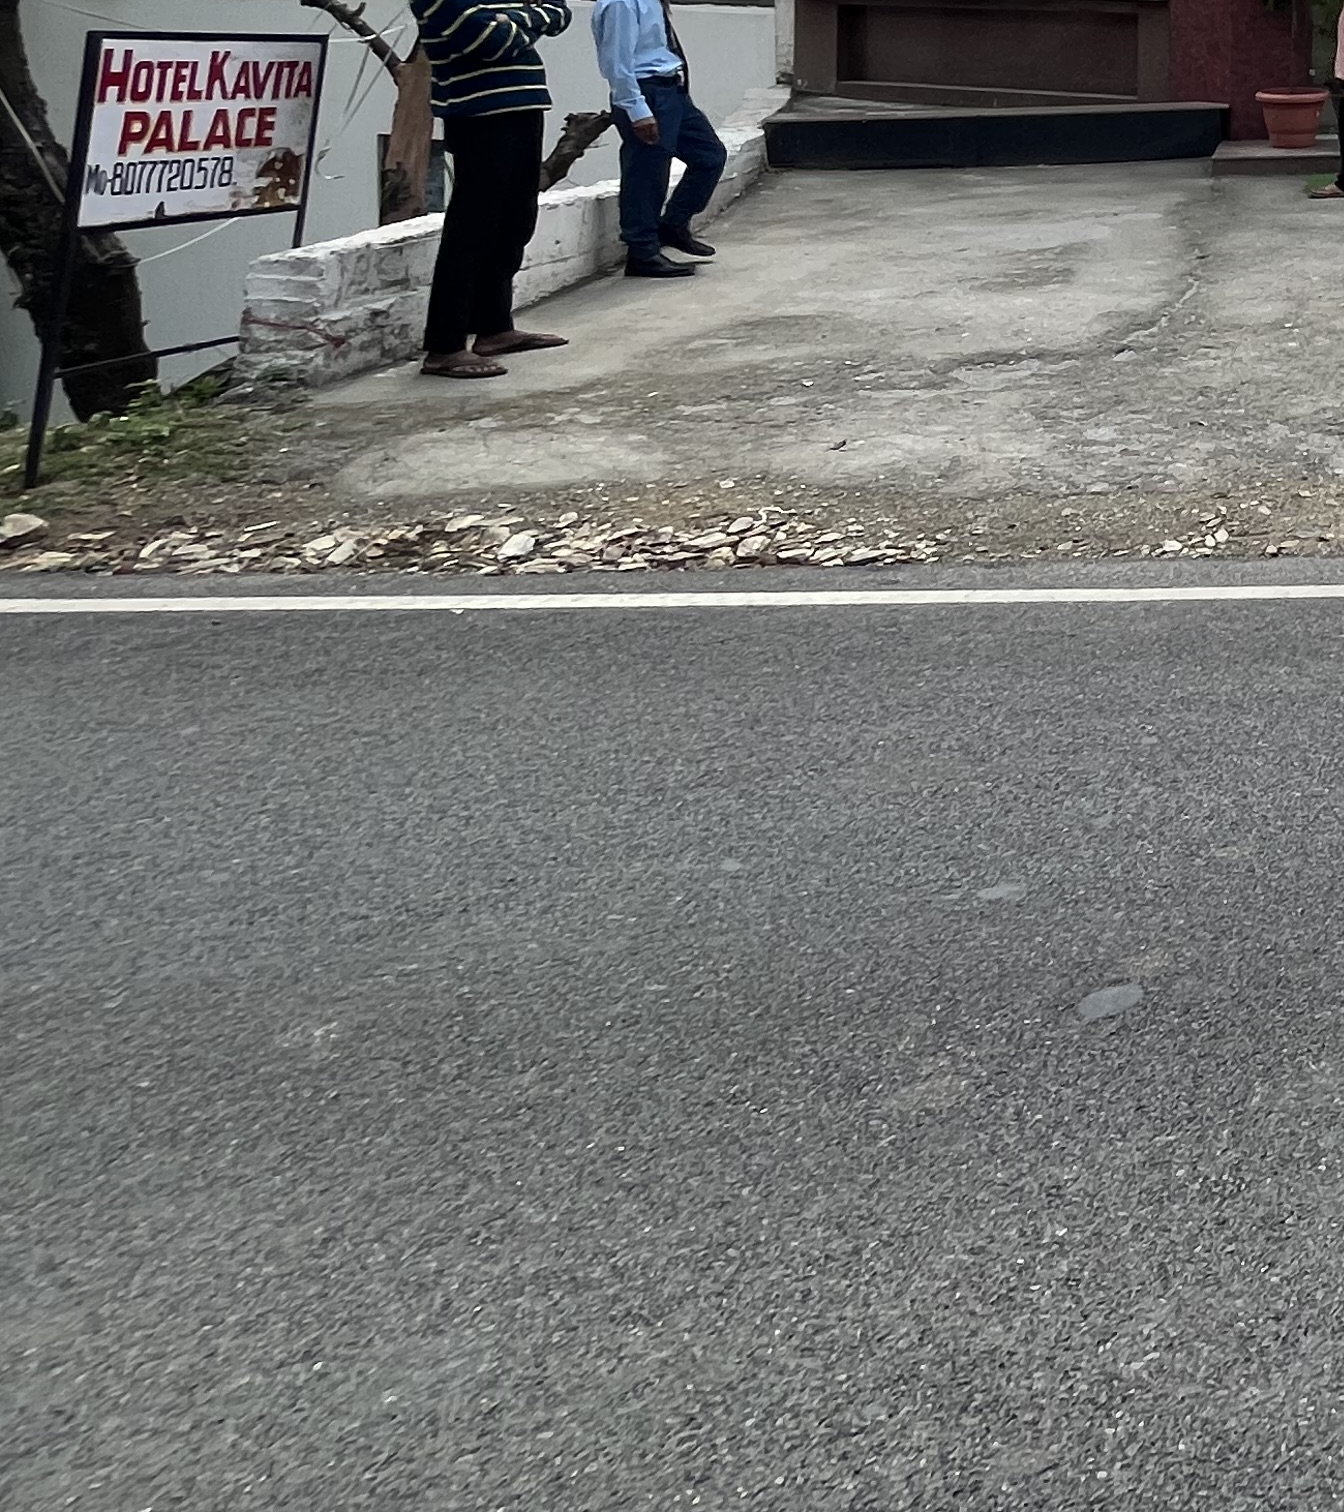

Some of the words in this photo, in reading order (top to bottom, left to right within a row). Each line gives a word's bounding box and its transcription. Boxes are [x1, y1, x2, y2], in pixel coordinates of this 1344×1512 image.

[97, 48, 203, 104] HOTEL
[205, 50, 313, 101] KAVITA
[117, 106, 278, 157] PALACE
